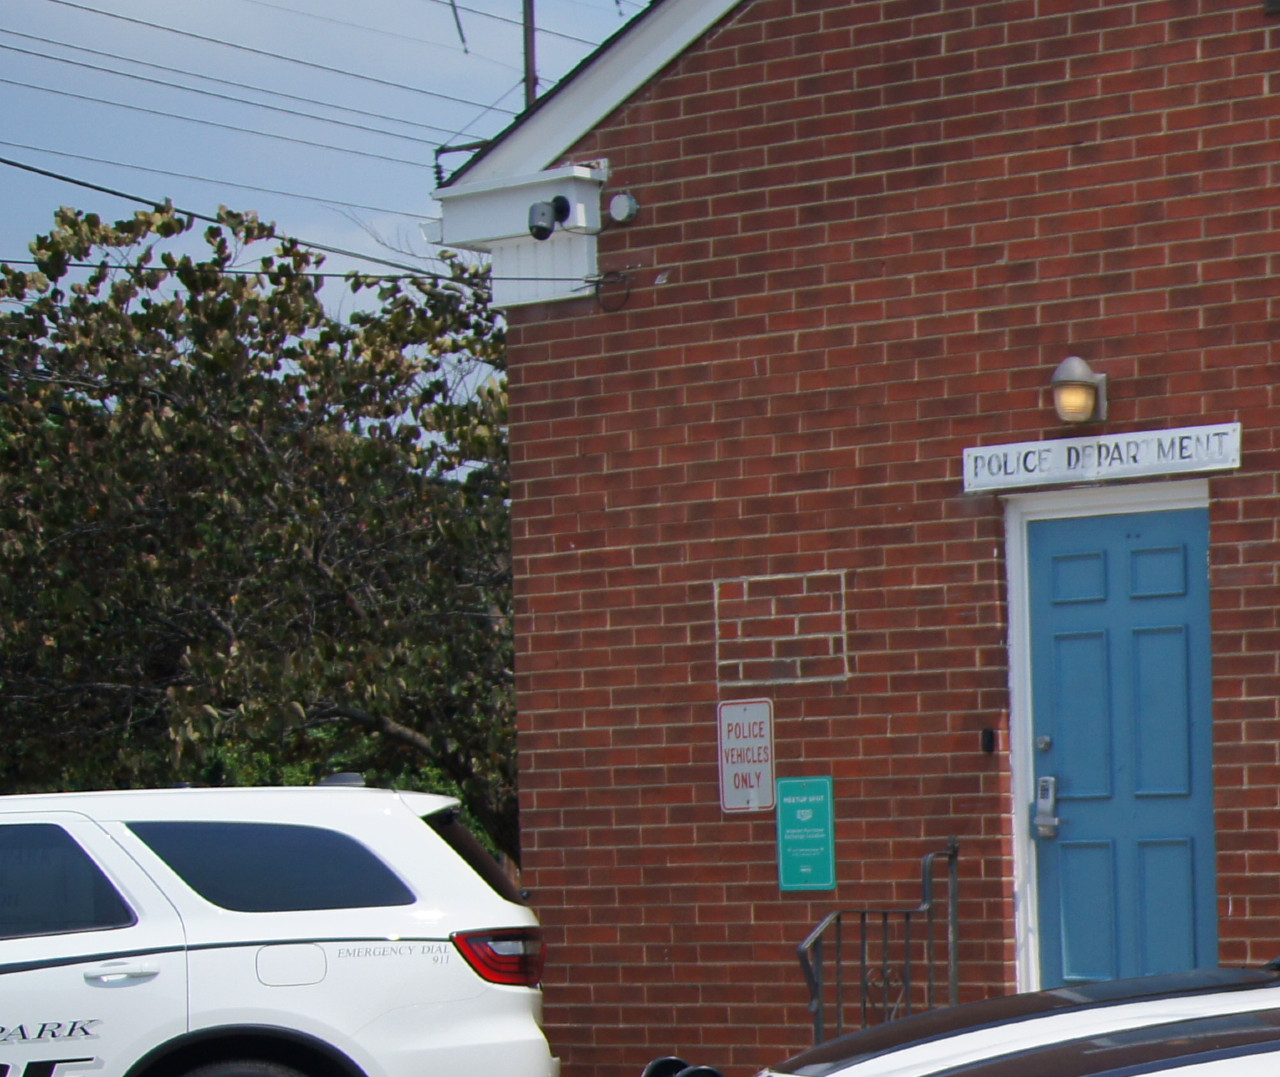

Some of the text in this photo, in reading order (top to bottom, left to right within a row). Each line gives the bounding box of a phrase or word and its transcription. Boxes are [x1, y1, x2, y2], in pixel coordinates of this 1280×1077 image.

[973, 448, 1051, 478] POLICE
[727, 721, 765, 740] POLICE
[724, 746, 769, 764] VEHICLES
[733, 772, 761, 789] ONLY
[337, 944, 450, 958] EMERGENCY DIAL
[432, 955, 449, 965] 911
[0, 1018, 100, 1041] ARK
